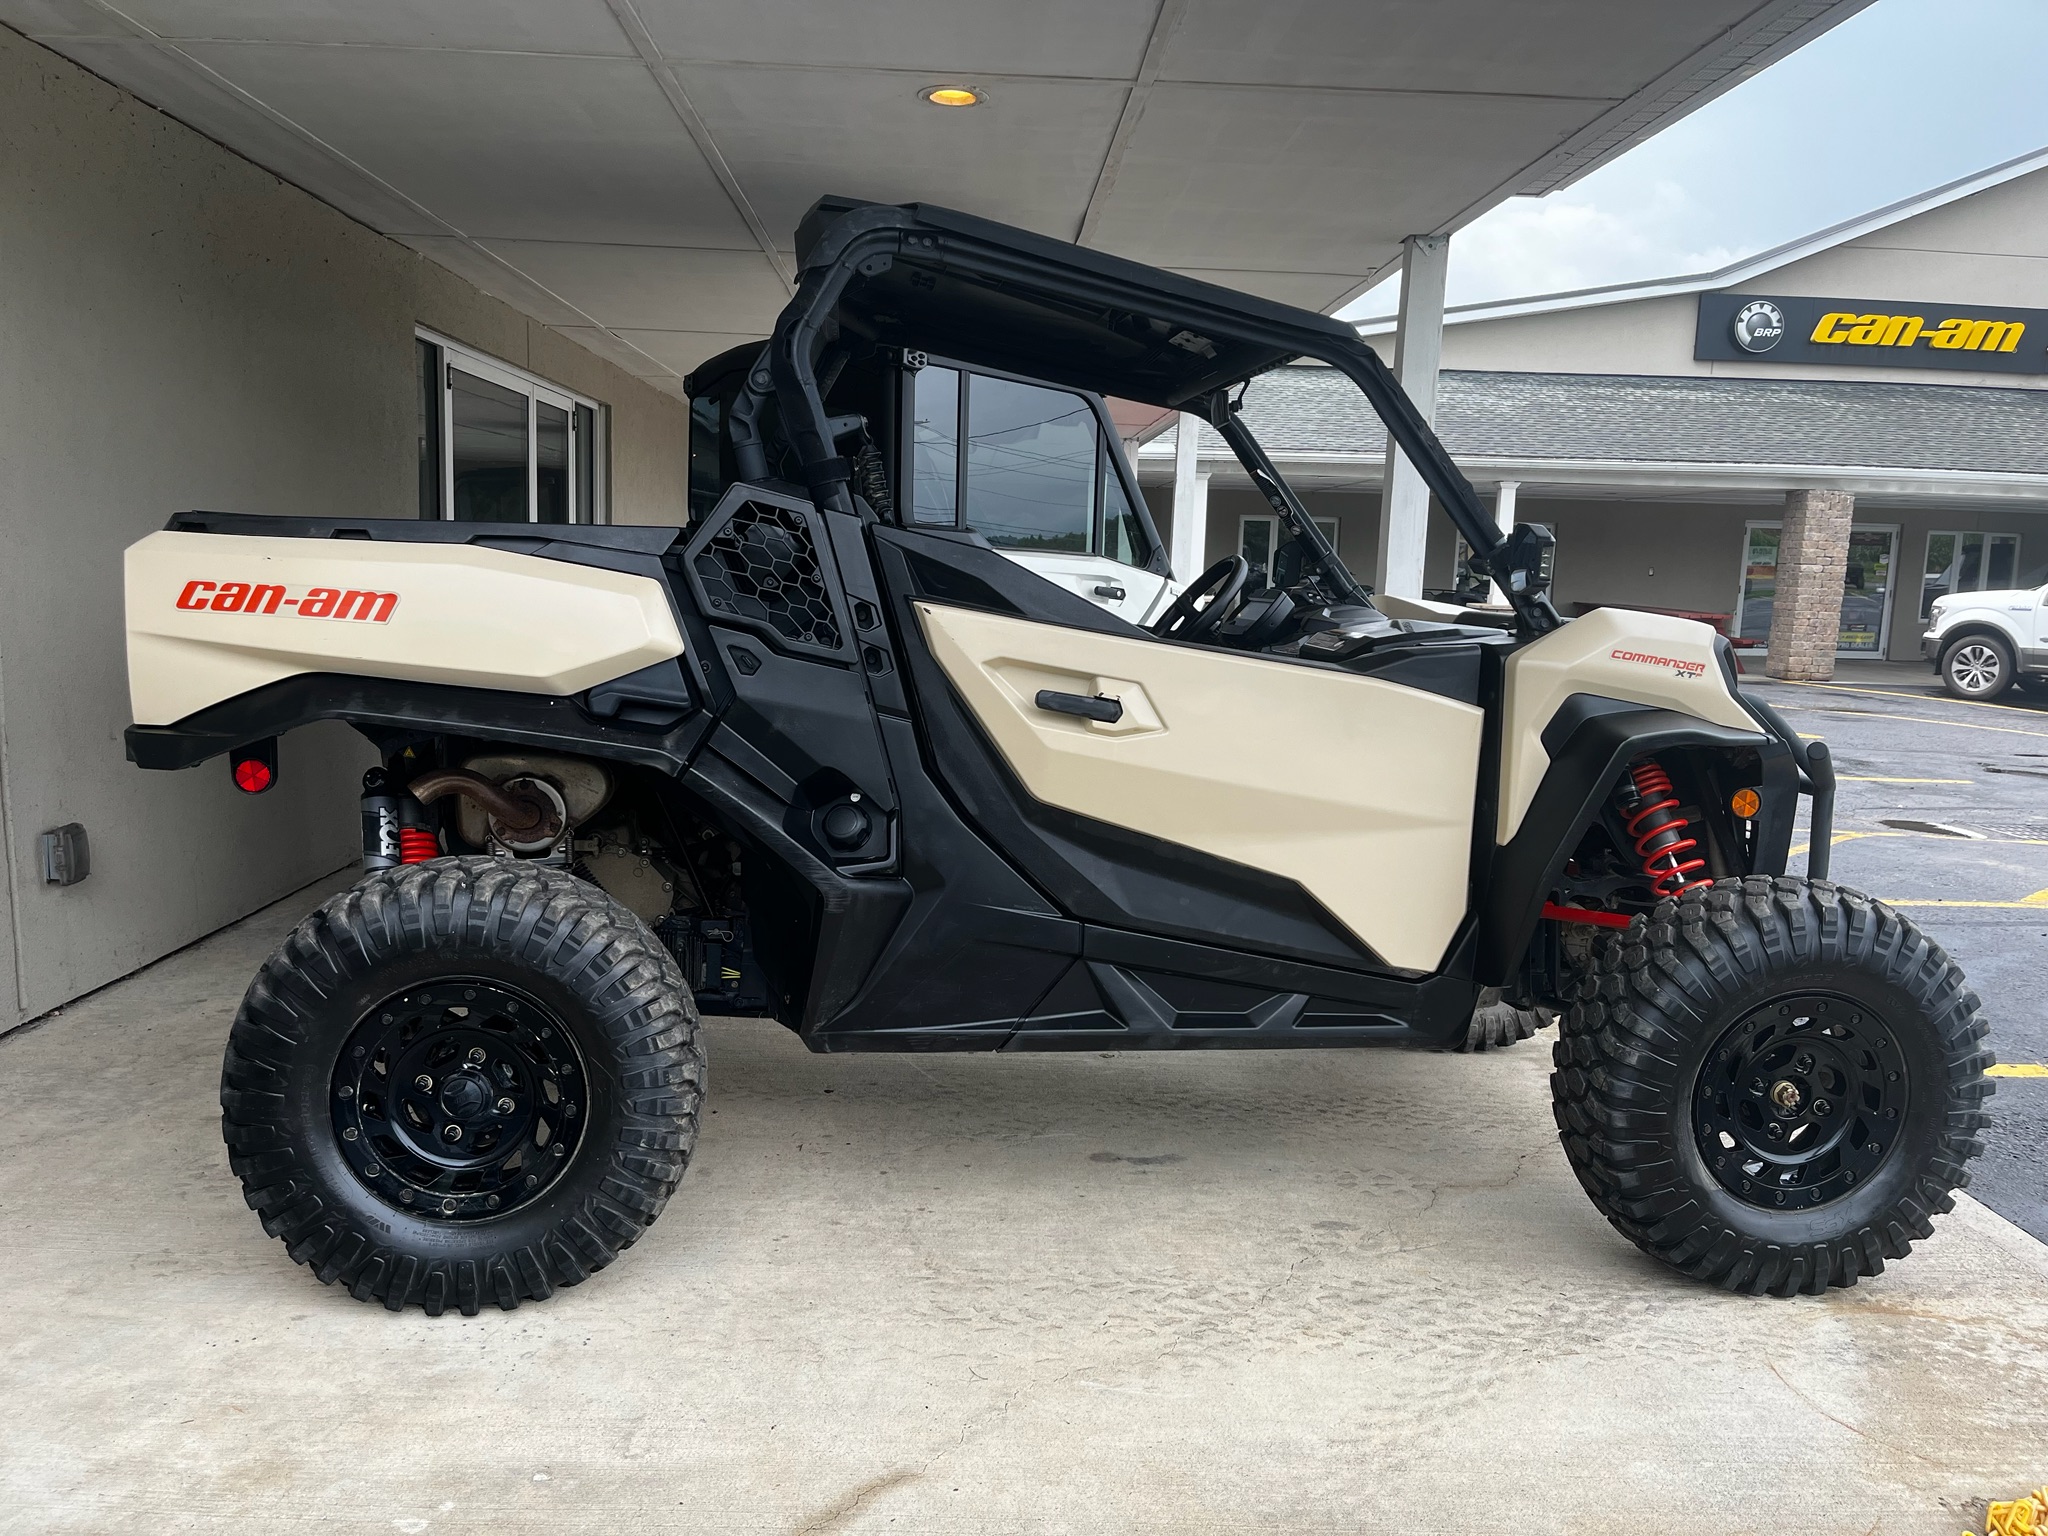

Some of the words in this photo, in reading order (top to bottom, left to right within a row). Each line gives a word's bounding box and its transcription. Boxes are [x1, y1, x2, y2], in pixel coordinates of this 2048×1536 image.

[1753, 328, 1783, 338] BRP
[1810, 312, 2025, 353] can-am
[175, 580, 399, 622] can-am
[1611, 649, 1706, 673] COMMANDER
[378, 807, 400, 858] FOX
